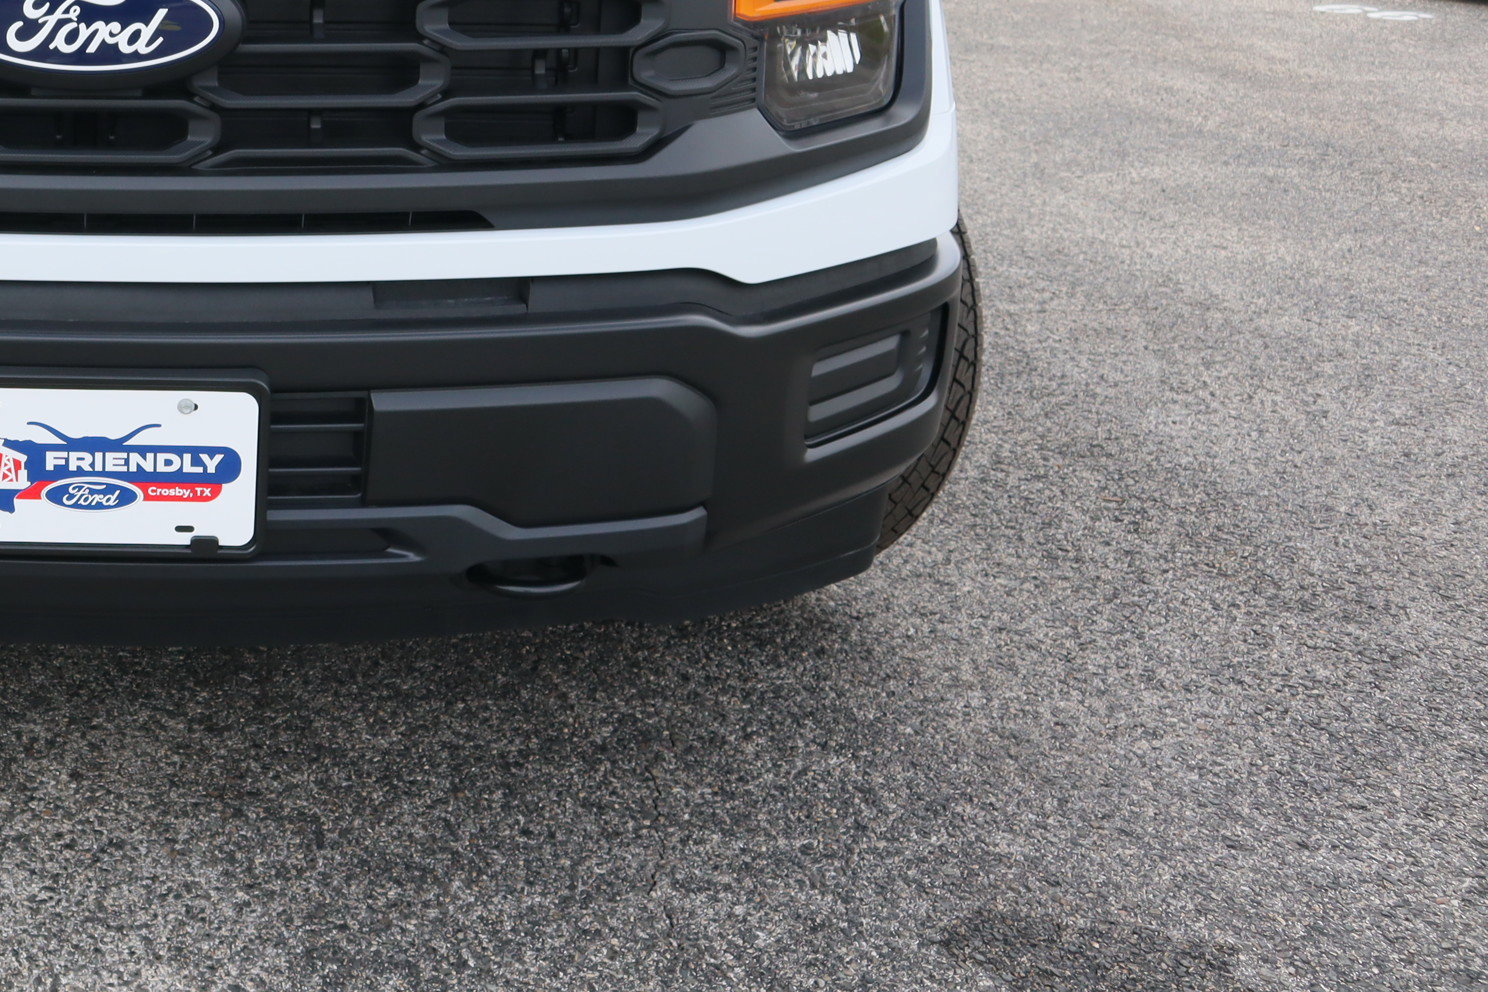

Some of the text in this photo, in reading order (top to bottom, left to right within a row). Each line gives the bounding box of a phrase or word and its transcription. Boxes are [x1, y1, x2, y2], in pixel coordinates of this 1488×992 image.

[45, 451, 225, 474] FRIENDLY
[62, 483, 121, 506] Ford
[147, 486, 212, 498] Crosby, TX
